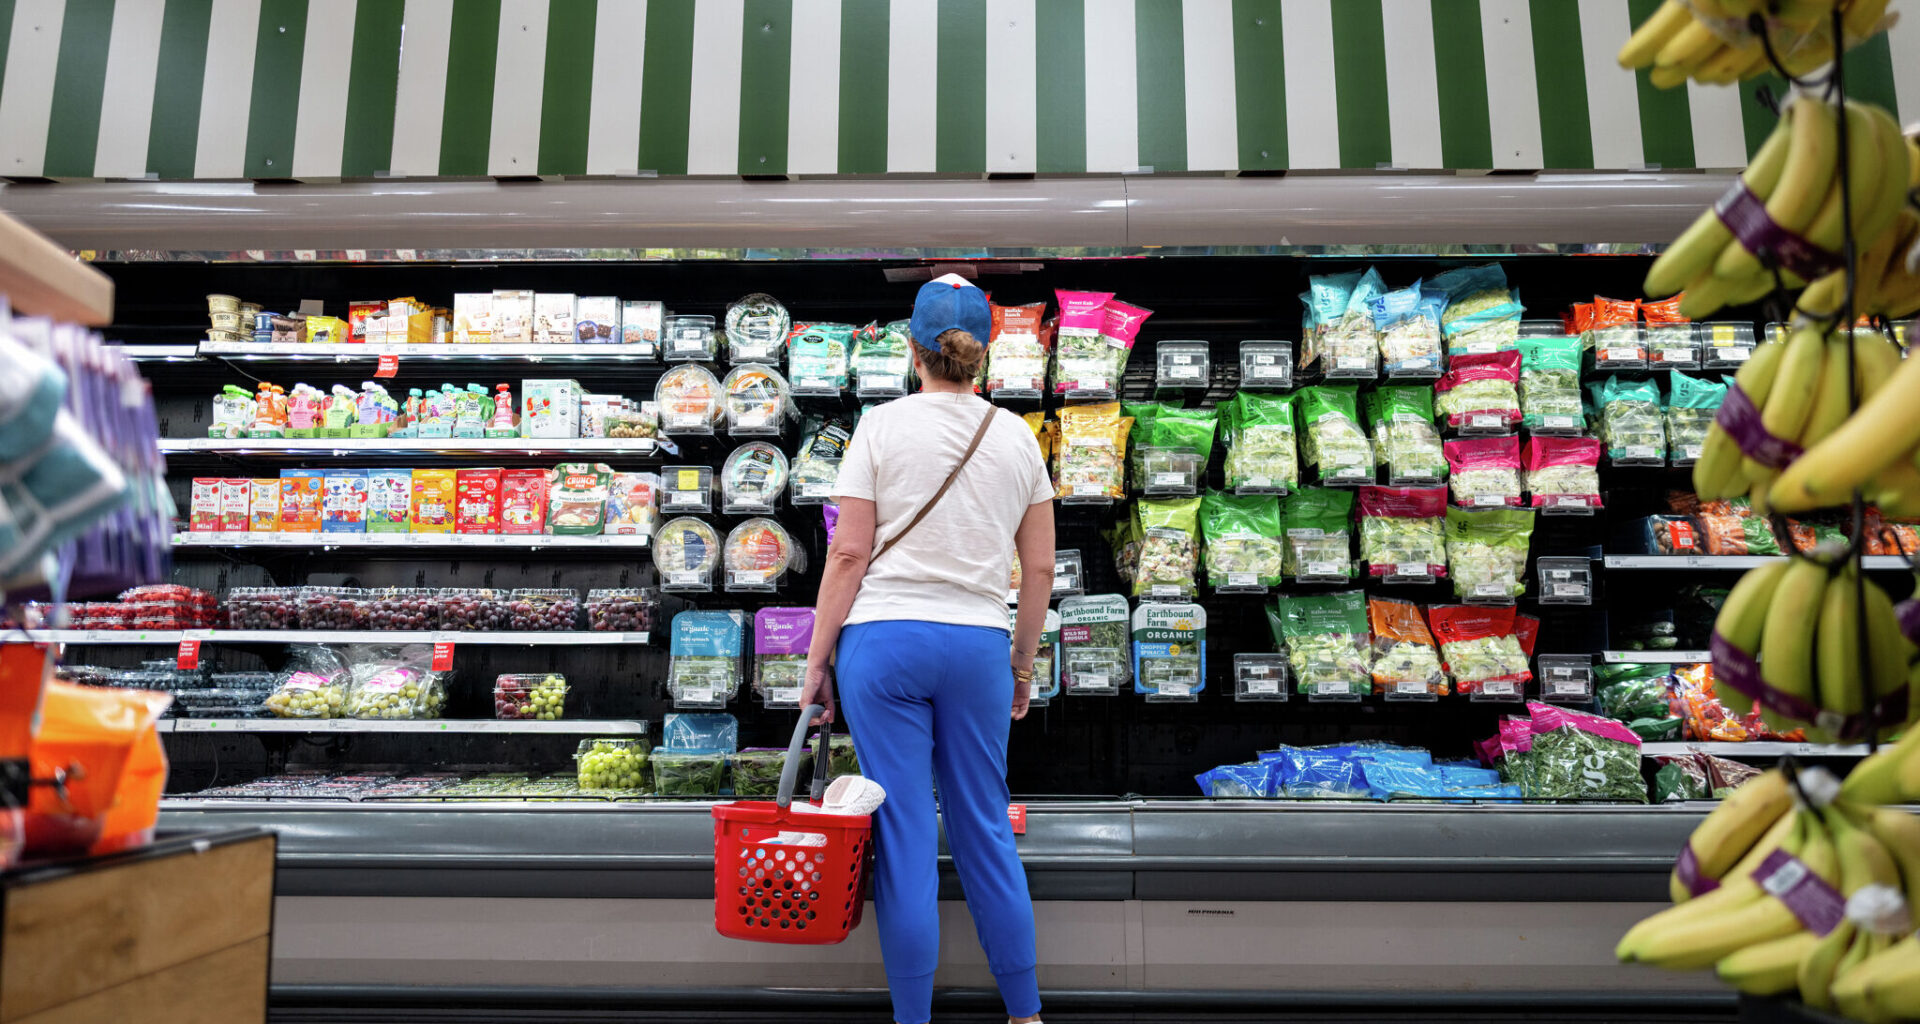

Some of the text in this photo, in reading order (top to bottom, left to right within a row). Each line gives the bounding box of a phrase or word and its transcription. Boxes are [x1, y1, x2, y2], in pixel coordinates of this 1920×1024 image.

[1061, 606, 1125, 618] Earthbound Farm
[1147, 609, 1194, 617] Earthbound
[1147, 618, 1167, 626] Farm
[681, 625, 709, 633] organic
[765, 623, 793, 631] organic
